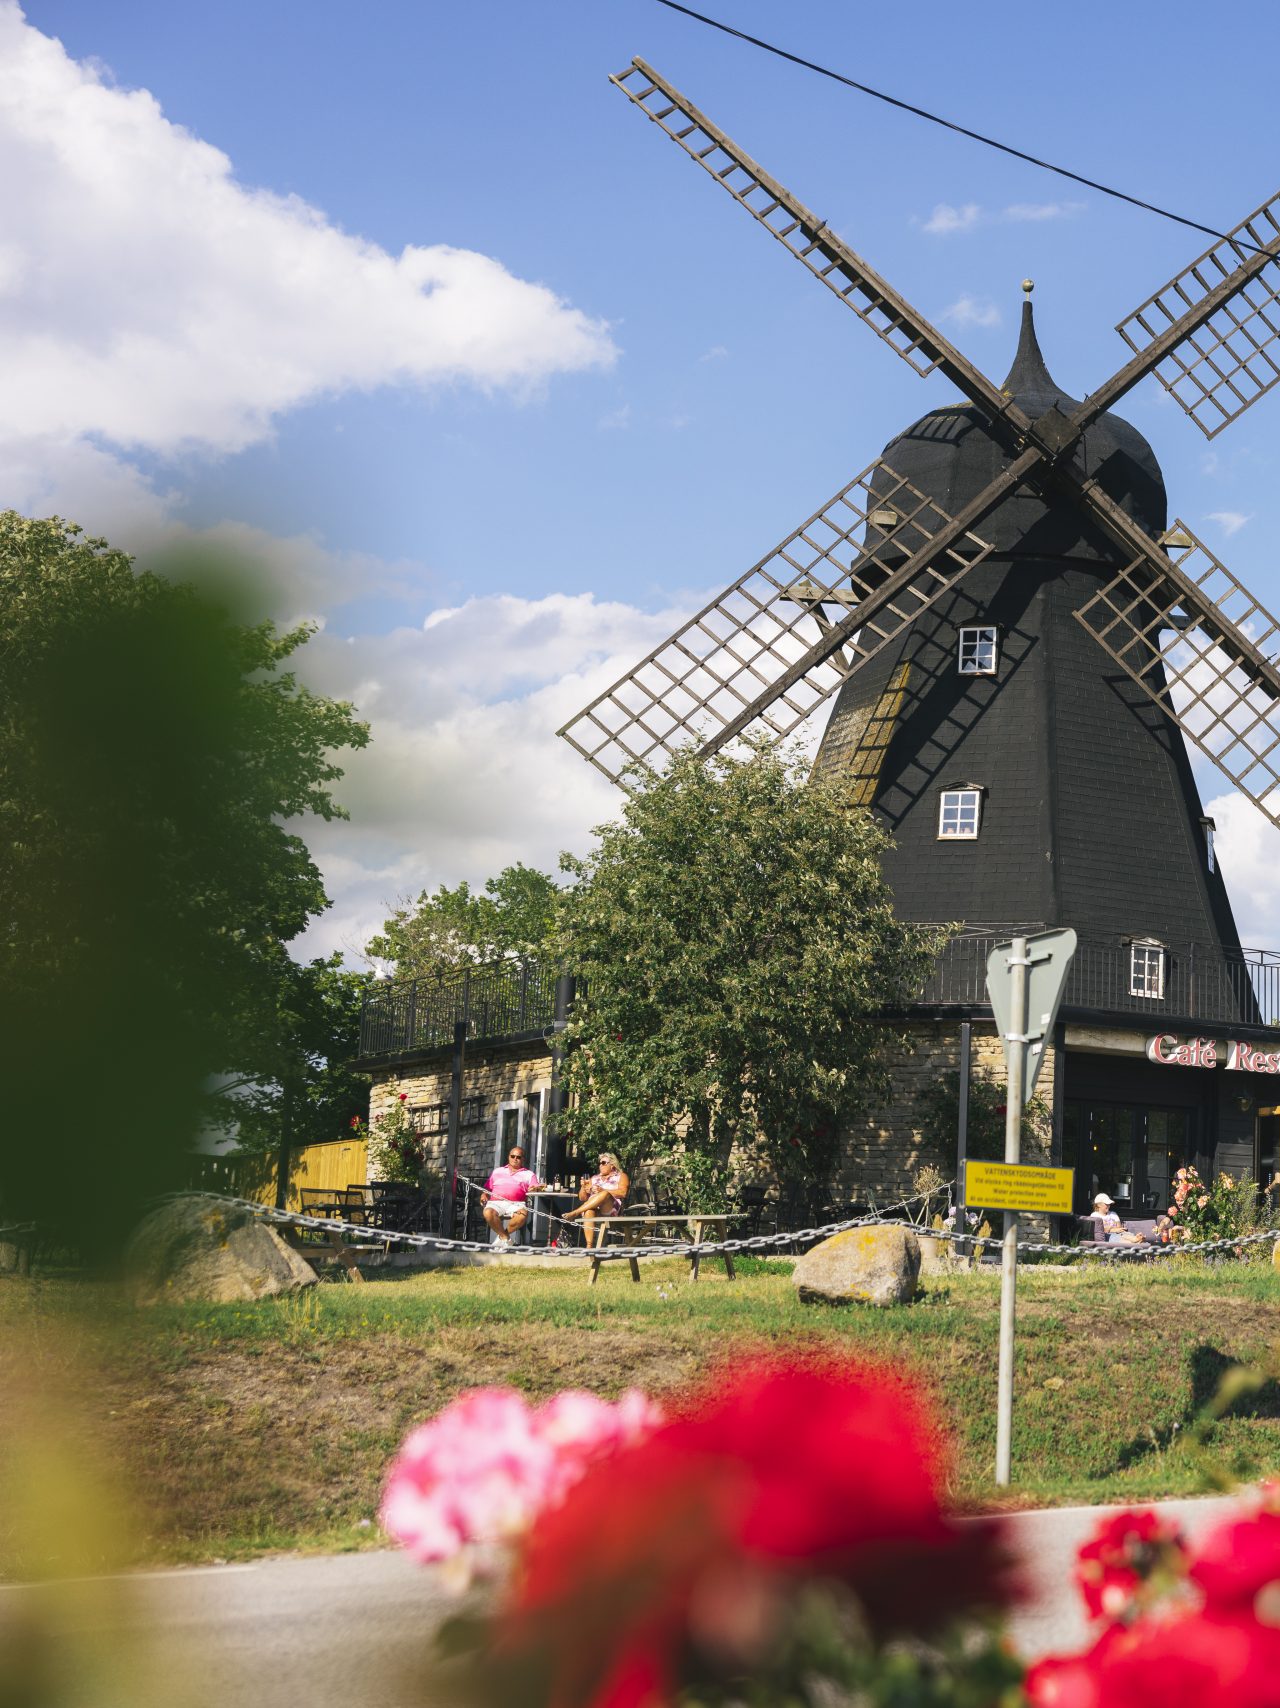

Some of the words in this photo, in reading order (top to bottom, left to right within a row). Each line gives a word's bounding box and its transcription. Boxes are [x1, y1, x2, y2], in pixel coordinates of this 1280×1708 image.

[1149, 1033, 1217, 1069] Café
[984, 1167, 1056, 1180] VATTENSKYDDSOMRÅDE
[1009, 1189, 1034, 1197] protection
